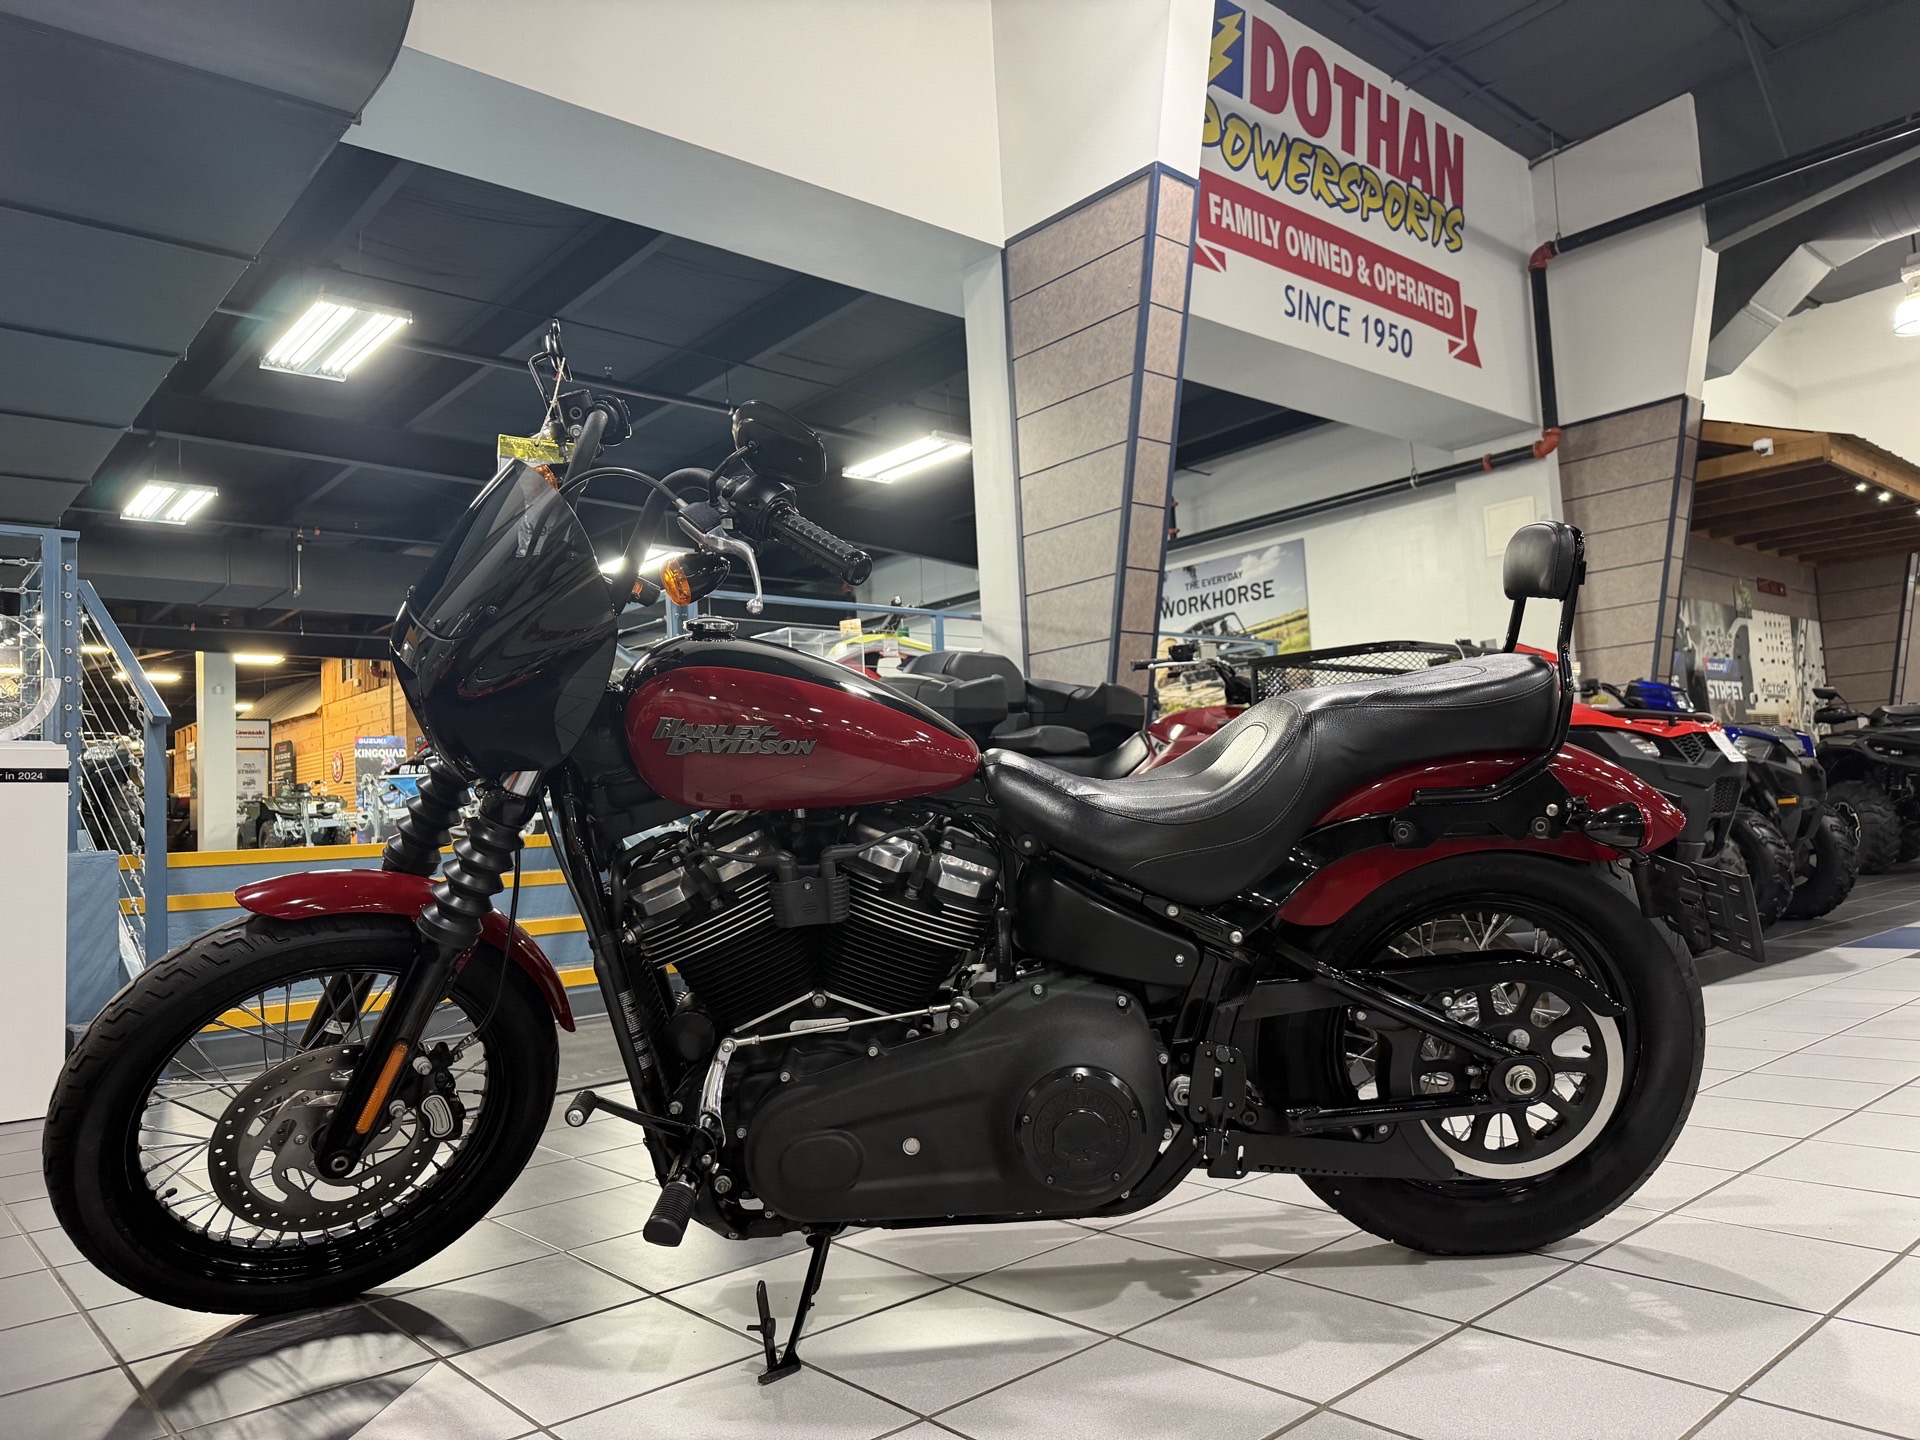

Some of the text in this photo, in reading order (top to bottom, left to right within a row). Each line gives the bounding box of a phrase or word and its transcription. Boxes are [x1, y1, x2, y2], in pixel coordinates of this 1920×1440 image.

[1250, 15, 1464, 207] DOTHAN
[1208, 192, 1454, 319] FAMILY OWNED & OPERATED
[1284, 284, 1412, 358] SINCE 1950
[1185, 570, 1244, 591] THE EVERYDAY
[1160, 579, 1275, 620] WORKHORSE
[1707, 680, 1744, 700] STREET
[652, 716, 782, 739] HARLEY-
[355, 748, 407, 758] KINGQUAD
[666, 738, 817, 755] DAVIDSON
[5, 771, 15, 780] in
[18, 771, 44, 780] 2024
